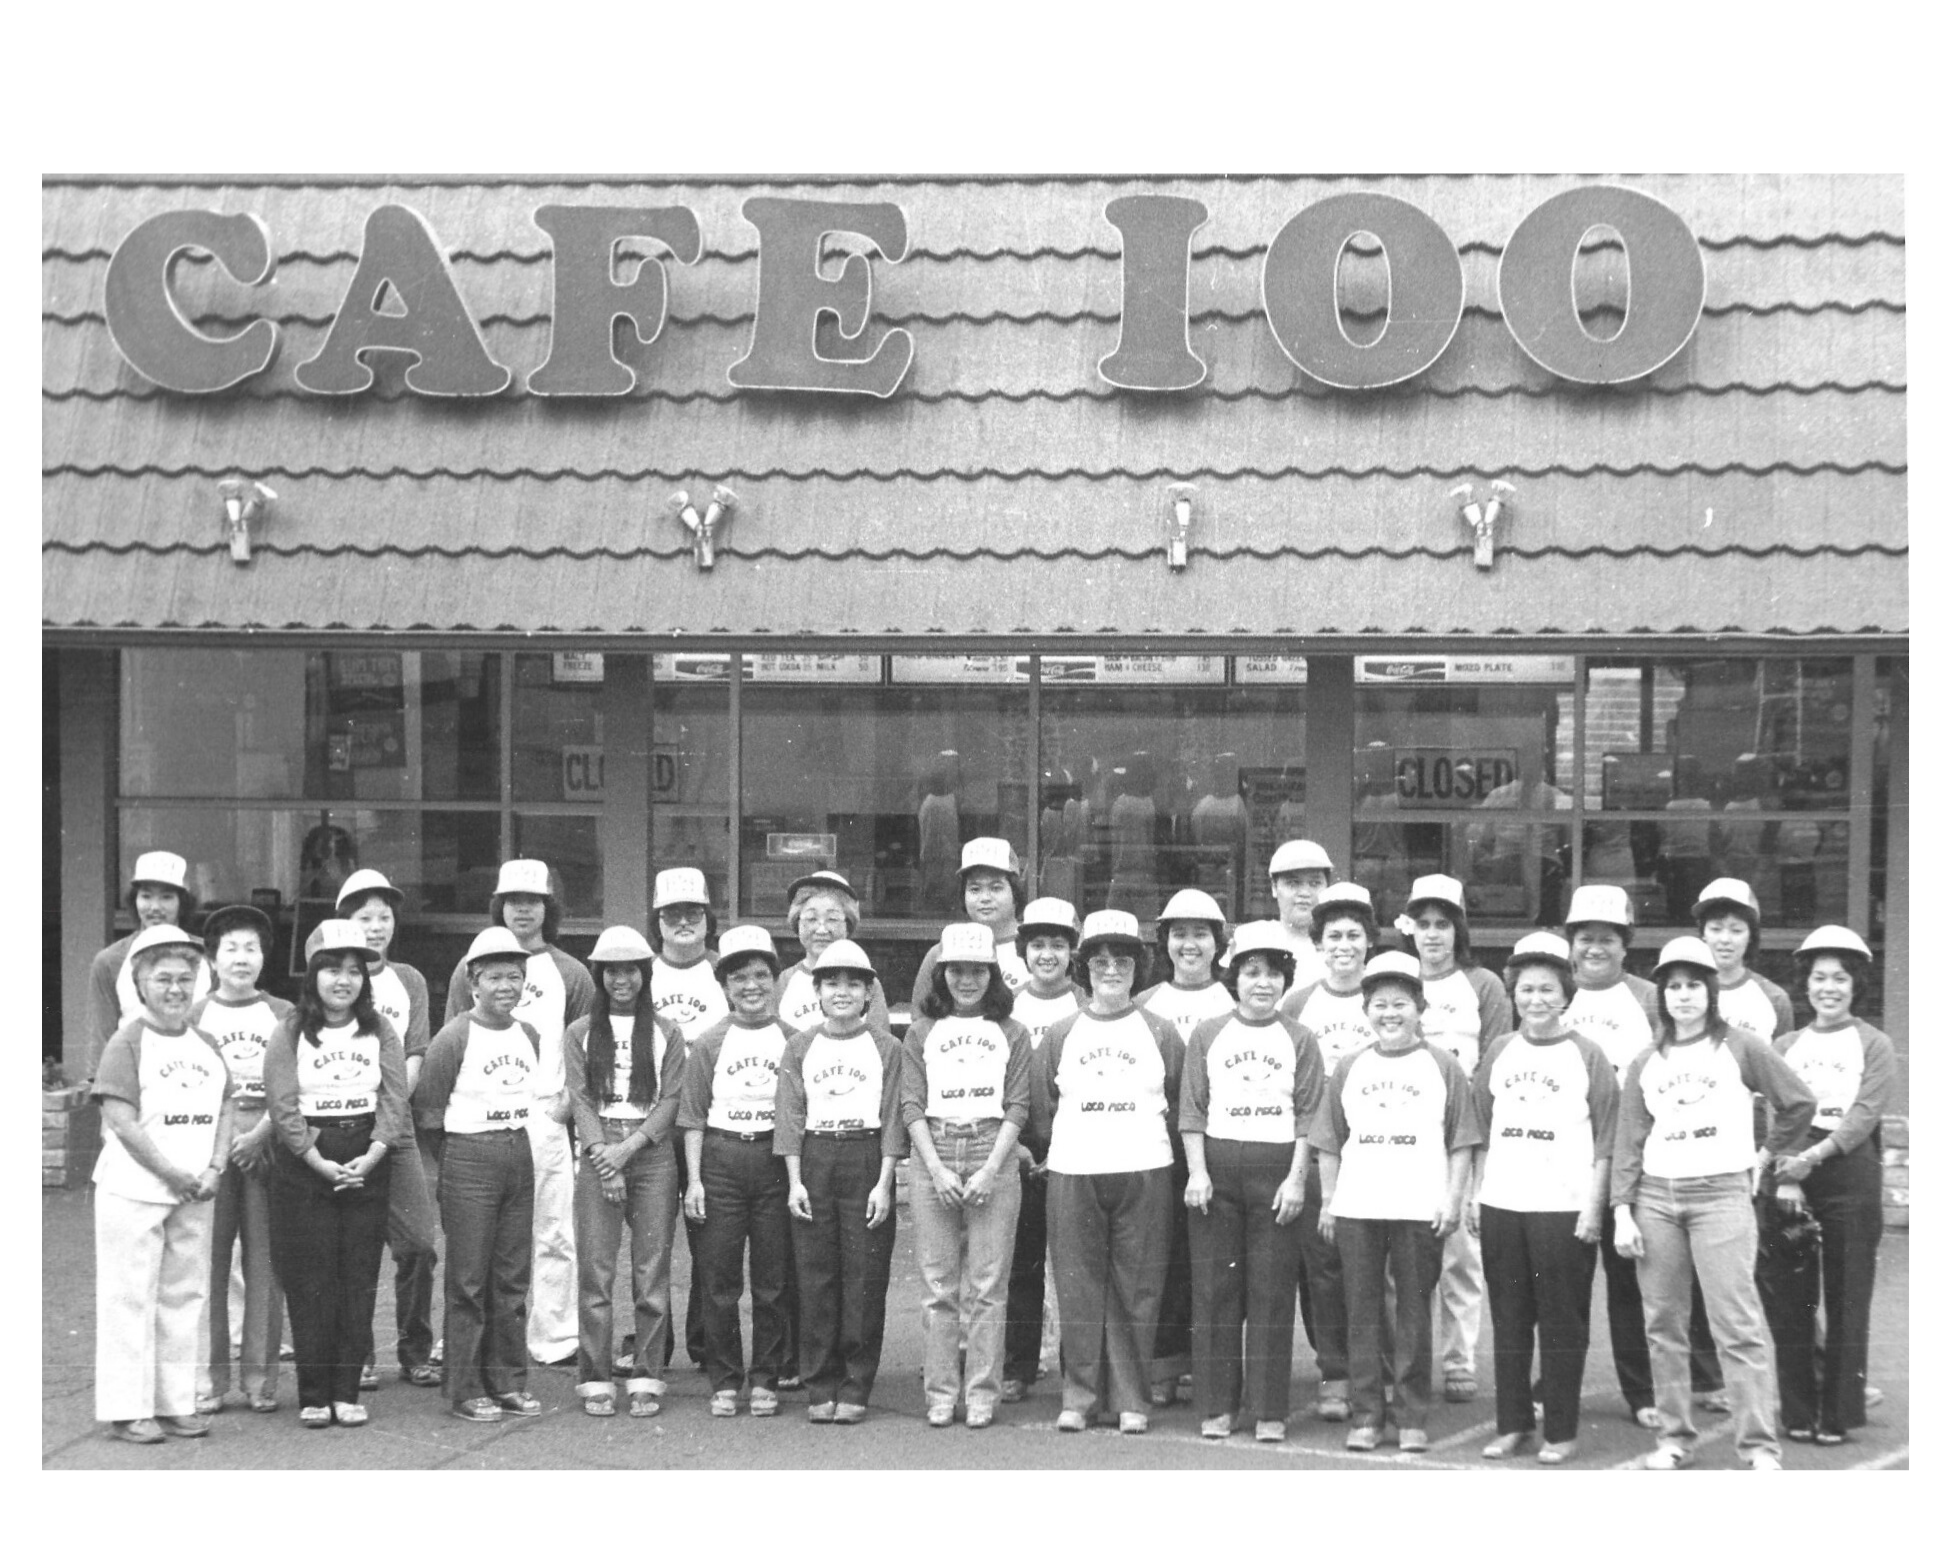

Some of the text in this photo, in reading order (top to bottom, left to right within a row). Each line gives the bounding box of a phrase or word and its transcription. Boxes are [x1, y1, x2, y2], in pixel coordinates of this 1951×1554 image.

[104, 184, 1706, 398] CAFE 100
[1246, 663, 1277, 672] SALAD
[1484, 662, 1513, 672] PLATE
[566, 753, 676, 792] CLD
[1398, 756, 1514, 800] CLOSED
[525, 982, 544, 998] 100
[381, 1004, 400, 1019] 100
[688, 996, 707, 1013] 100
[794, 1001, 823, 1019] CAF
[1315, 1022, 1372, 1040] CAFE 100
[940, 1034, 997, 1053] CAFE 100
[313, 1050, 371, 1070] CAFE 100
[1079, 1046, 1137, 1066] CAFE 100
[1224, 1050, 1283, 1071] CAFE 100
[159, 1060, 210, 1079] CAFE 100
[482, 1053, 531, 1076] CAFE 100
[727, 1056, 759, 1077] CAFE
[813, 1065, 868, 1084] CAFE 100
[1504, 1070, 1561, 1093] CAFE 100
[1697, 1074, 1718, 1089] 100
[245, 1082, 266, 1093] MOC
[941, 1086, 995, 1100] LOCO MOCO
[1361, 1081, 1421, 1097] CAFE 100
[315, 1097, 370, 1112] LOCO MOCO
[1081, 1101, 1136, 1113] LOCO MOCO
[1254, 1105, 1283, 1117] MOCO
[164, 1114, 214, 1126] LOCO MOCO
[486, 1109, 511, 1122] LOCO
[728, 1109, 776, 1121] LOCO MOC
[837, 1117, 865, 1129] MOCO
[1358, 1133, 1417, 1146] LOCO MOCO
[1526, 1129, 1556, 1142] MOCO
